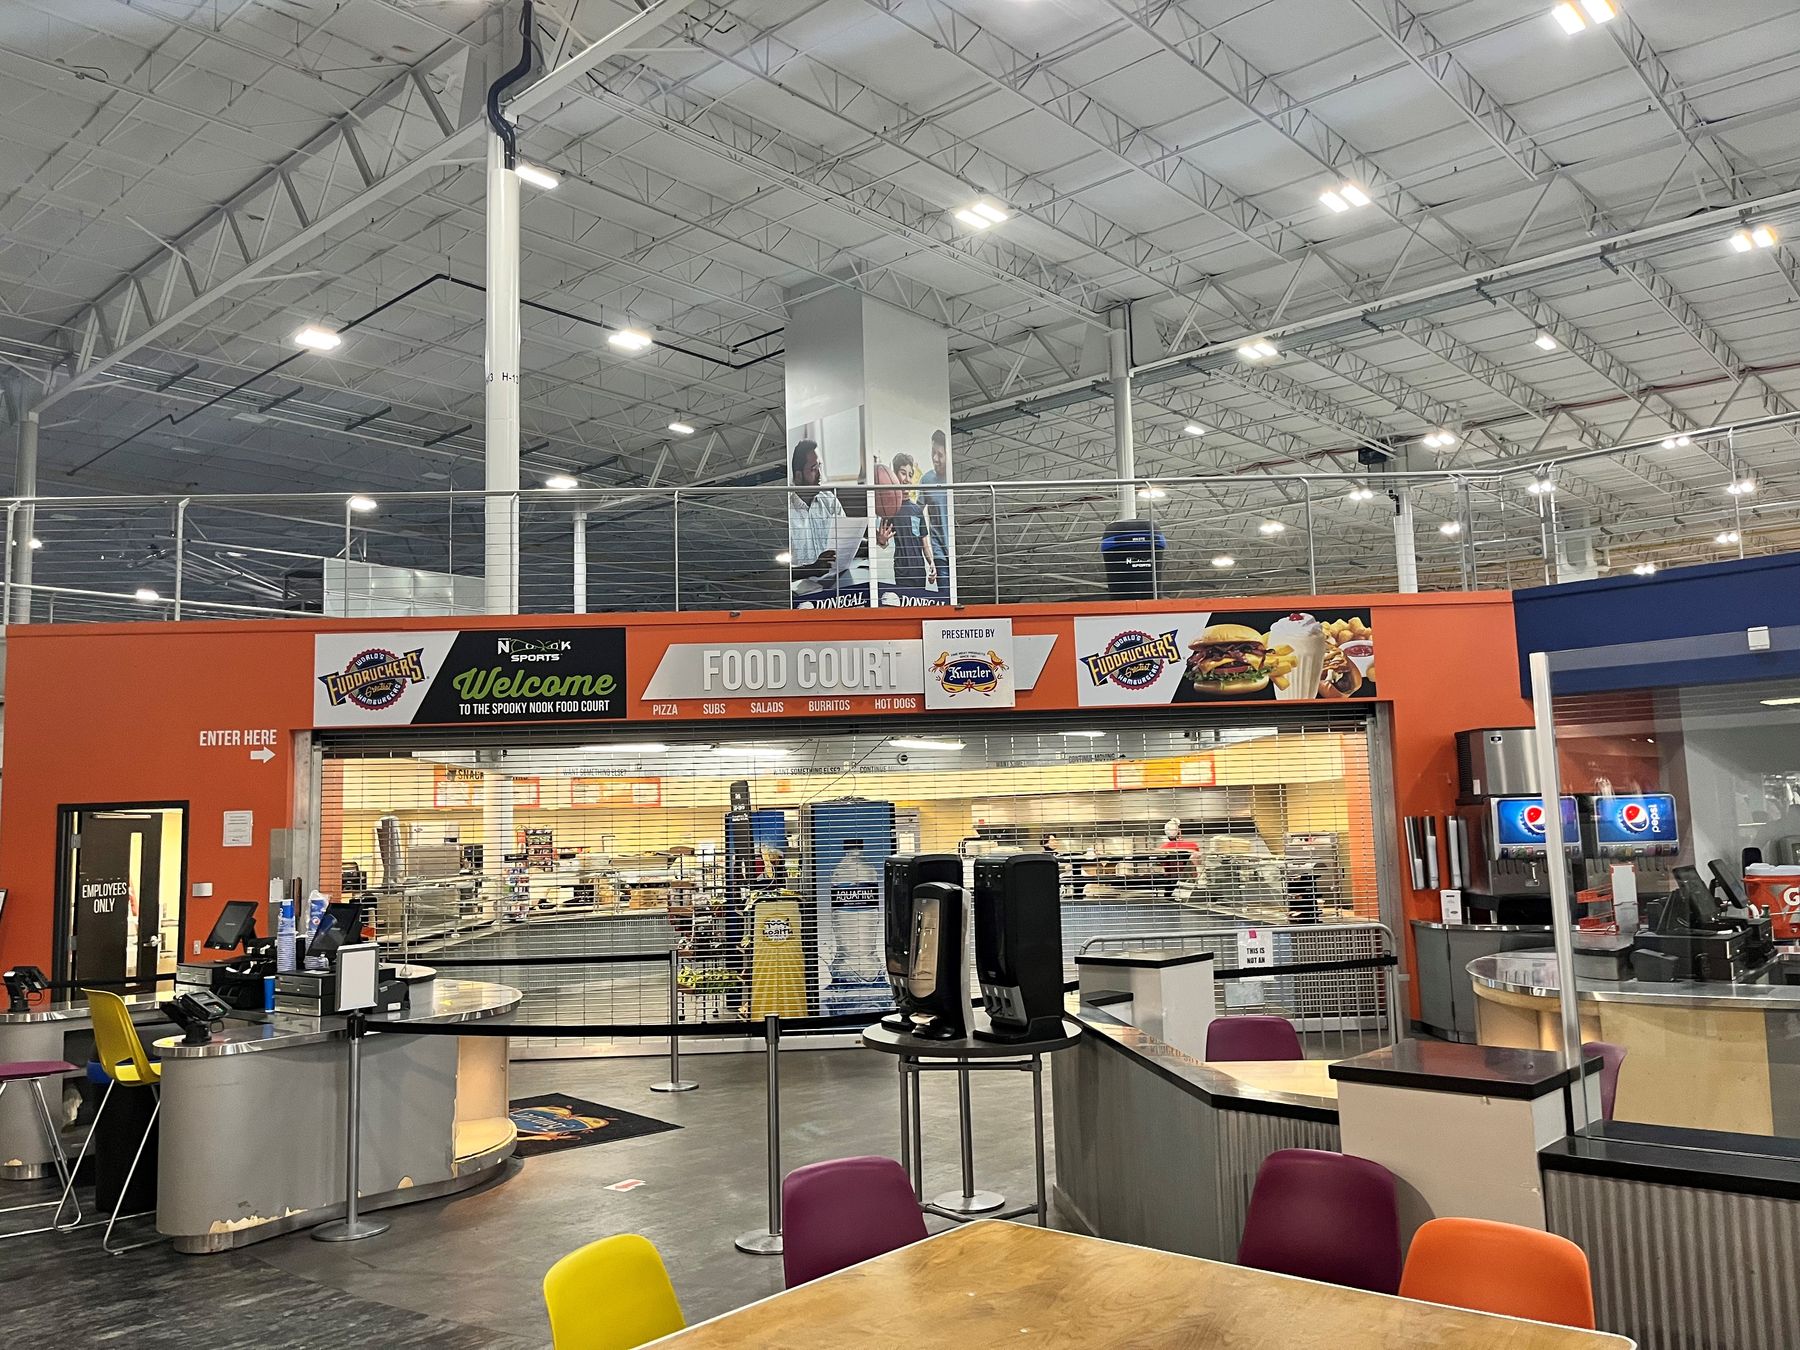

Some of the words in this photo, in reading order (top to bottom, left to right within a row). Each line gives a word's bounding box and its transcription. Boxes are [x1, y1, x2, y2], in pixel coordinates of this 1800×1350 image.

[941, 629, 984, 639] PRESENTED
[985, 628, 995, 638] BY
[511, 654, 560, 663] SPORTS
[1088, 633, 1179, 686] FUDDRUCKERS
[702, 649, 788, 692] FOOD
[797, 646, 902, 691] COURT
[948, 665, 992, 681] Kunzler
[1117, 664, 1159, 686] HAMBURGERS
[327, 652, 422, 705] FUDDRUCKERS
[452, 666, 617, 700] Welcome
[357, 683, 401, 705] HAMBURGERS
[459, 703, 471, 715] TO
[472, 703, 490, 715] THE
[491, 702, 528, 715] SPOOKY
[529, 701, 554, 714] NOOK
[556, 701, 579, 713] FOOD
[581, 700, 610, 712] COURT
[653, 704, 678, 716] PIZZA
[703, 703, 726, 715] SUBS
[750, 702, 784, 713] SALADS
[808, 699, 850, 712] BURRITOS
[874, 698, 891, 710] HOT
[893, 698, 916, 709] DOGS
[200, 730, 241, 746] ENTER
[244, 729, 277, 746] HERE
[1648, 804, 1661, 833] pepsi
[82, 882, 127, 898] EMPLOYEES
[93, 898, 115, 914] ONLY
